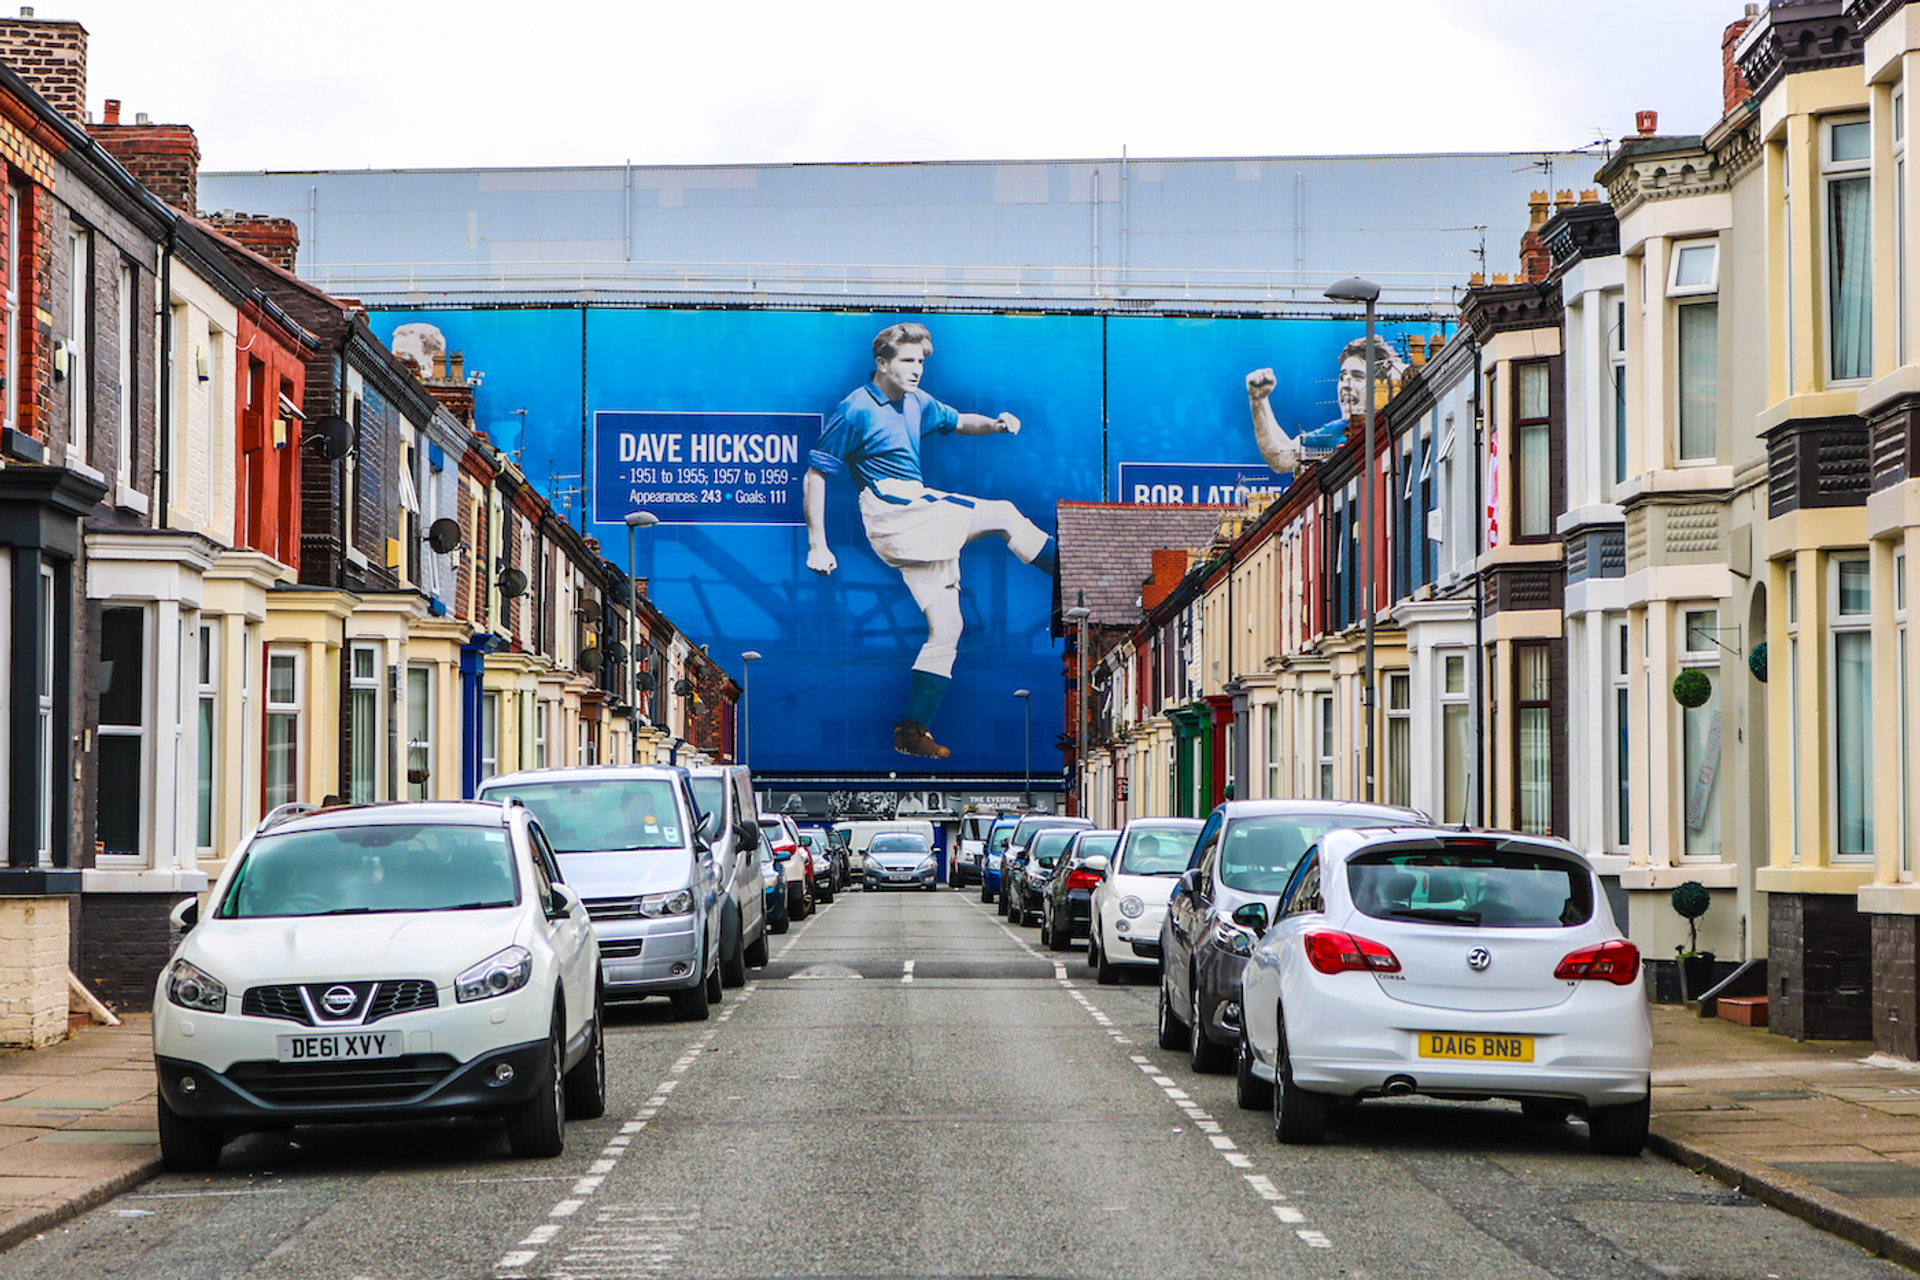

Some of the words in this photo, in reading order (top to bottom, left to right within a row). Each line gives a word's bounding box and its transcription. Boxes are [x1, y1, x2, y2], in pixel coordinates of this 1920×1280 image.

[619, 433, 682, 462] DAVE
[691, 434, 798, 463] HICKSON
[630, 467, 657, 484] 1951
[661, 469, 673, 484] to
[677, 468, 709, 486] 1955;
[713, 468, 741, 484] 1957
[744, 469, 756, 485] to
[760, 468, 788, 485] 1959
[629, 488, 698, 505] Appearances:
[700, 489, 722, 503] 243
[735, 489, 767, 504] Goals:
[769, 489, 787, 504] 111
[1134, 484, 1185, 506] BOB
[292, 1037, 339, 1058] DE61
[345, 1034, 386, 1056] XVY
[1431, 1035, 1476, 1056] DA16
[1482, 1038, 1522, 1057] BNB
